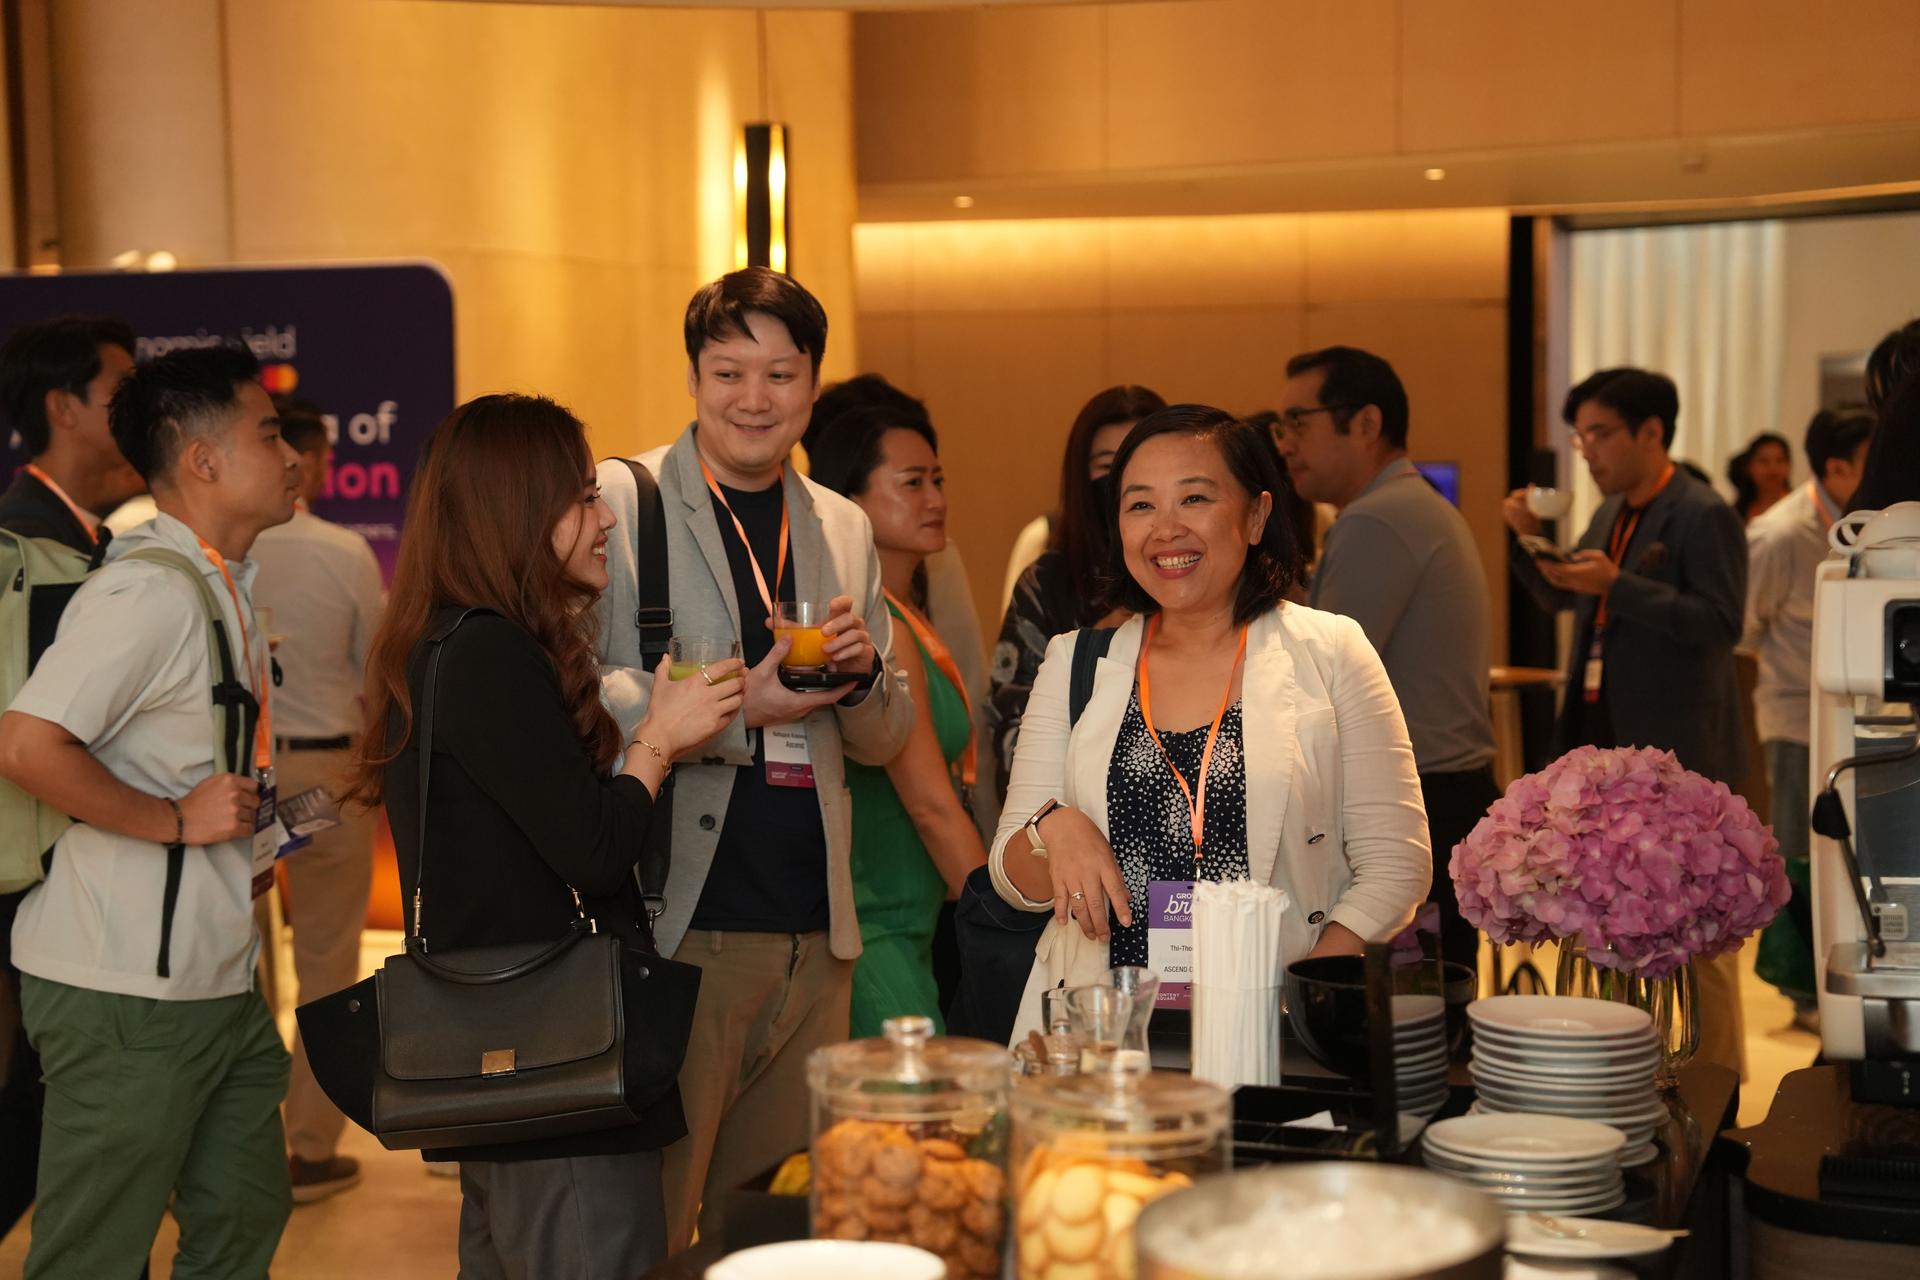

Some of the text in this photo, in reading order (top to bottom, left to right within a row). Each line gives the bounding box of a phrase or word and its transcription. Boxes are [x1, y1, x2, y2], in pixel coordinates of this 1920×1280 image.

[348, 400, 398, 446] of
[324, 449, 400, 498] ion
[1163, 894, 1192, 915] br
[1176, 892, 1192, 900] GRO
